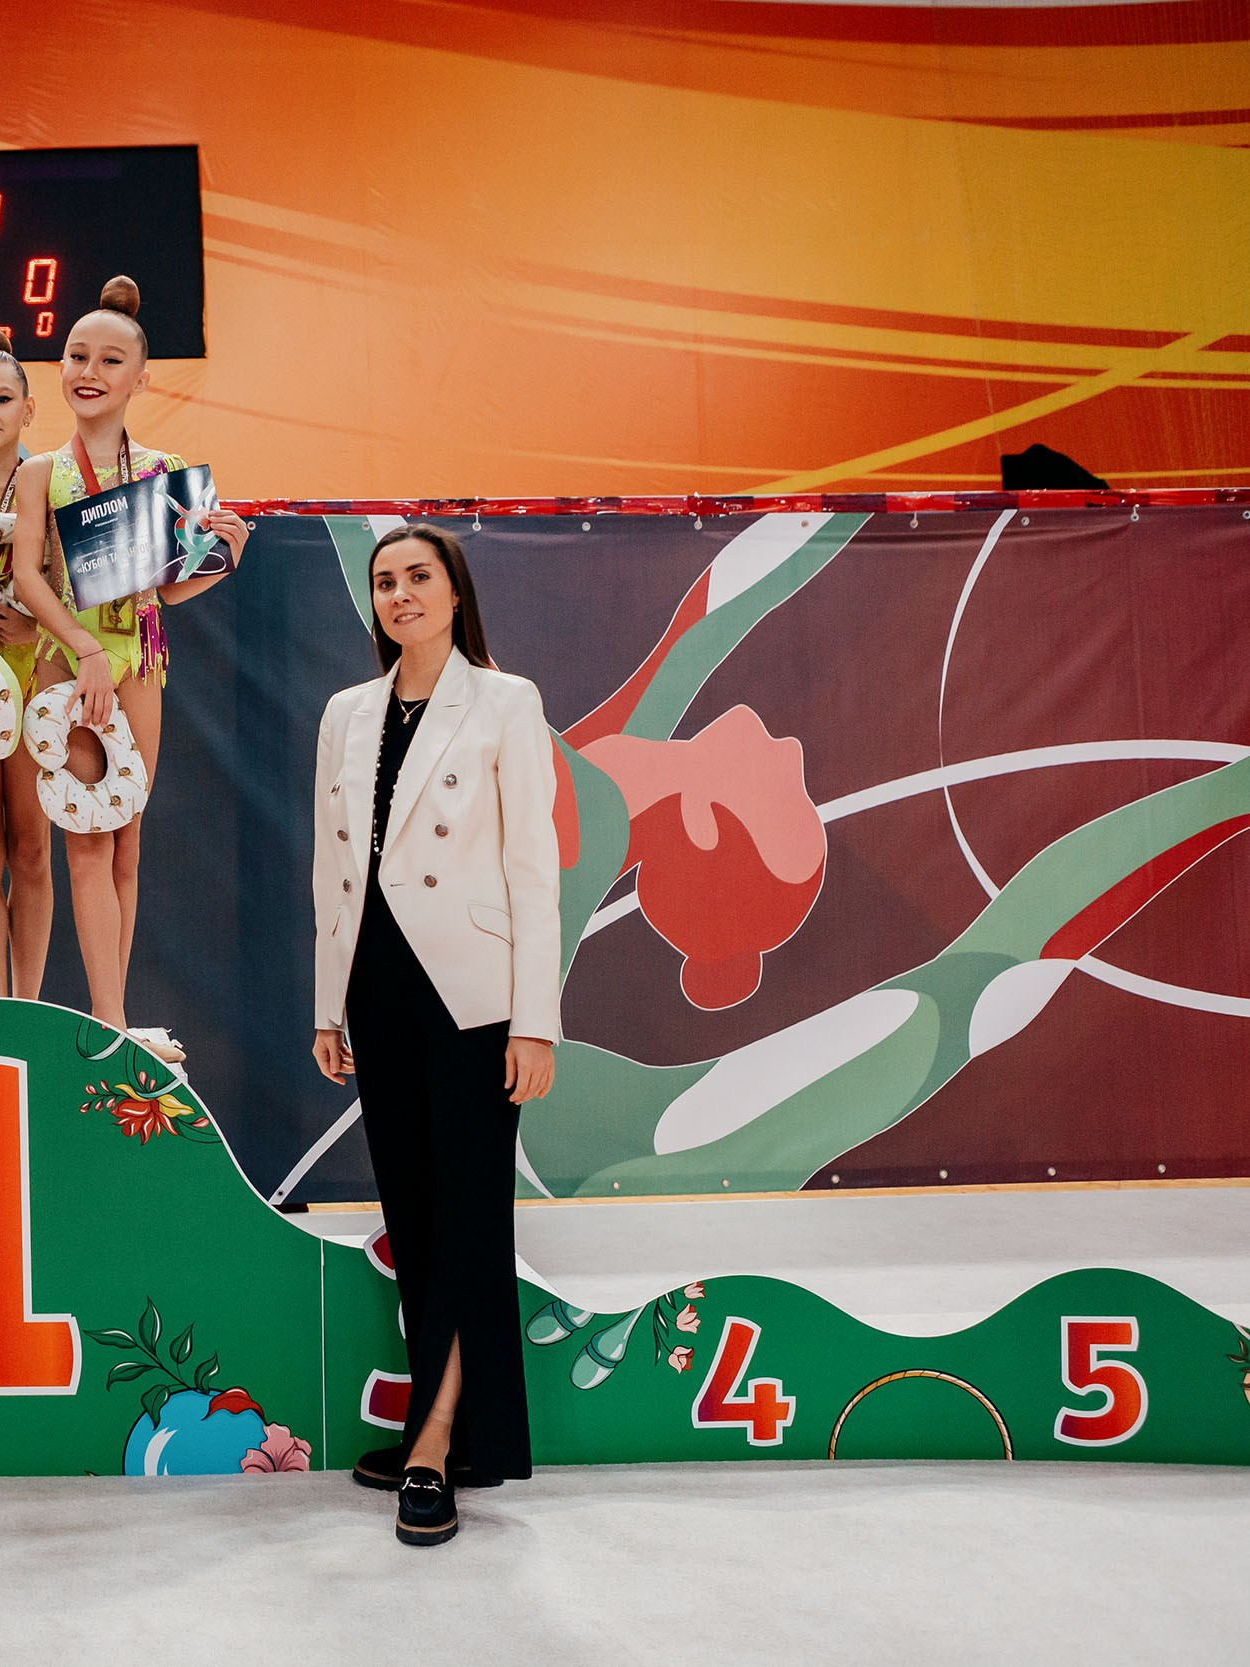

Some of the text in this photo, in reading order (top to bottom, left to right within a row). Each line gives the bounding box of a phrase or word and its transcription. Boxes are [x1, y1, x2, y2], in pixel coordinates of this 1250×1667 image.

[23, 258, 58, 304] 0
[36, 311, 54, 337] 0
[81, 496, 128, 526] ДИПЛОМ
[691, 1316, 796, 1447] 4
[1053, 1316, 1148, 1447] 5
